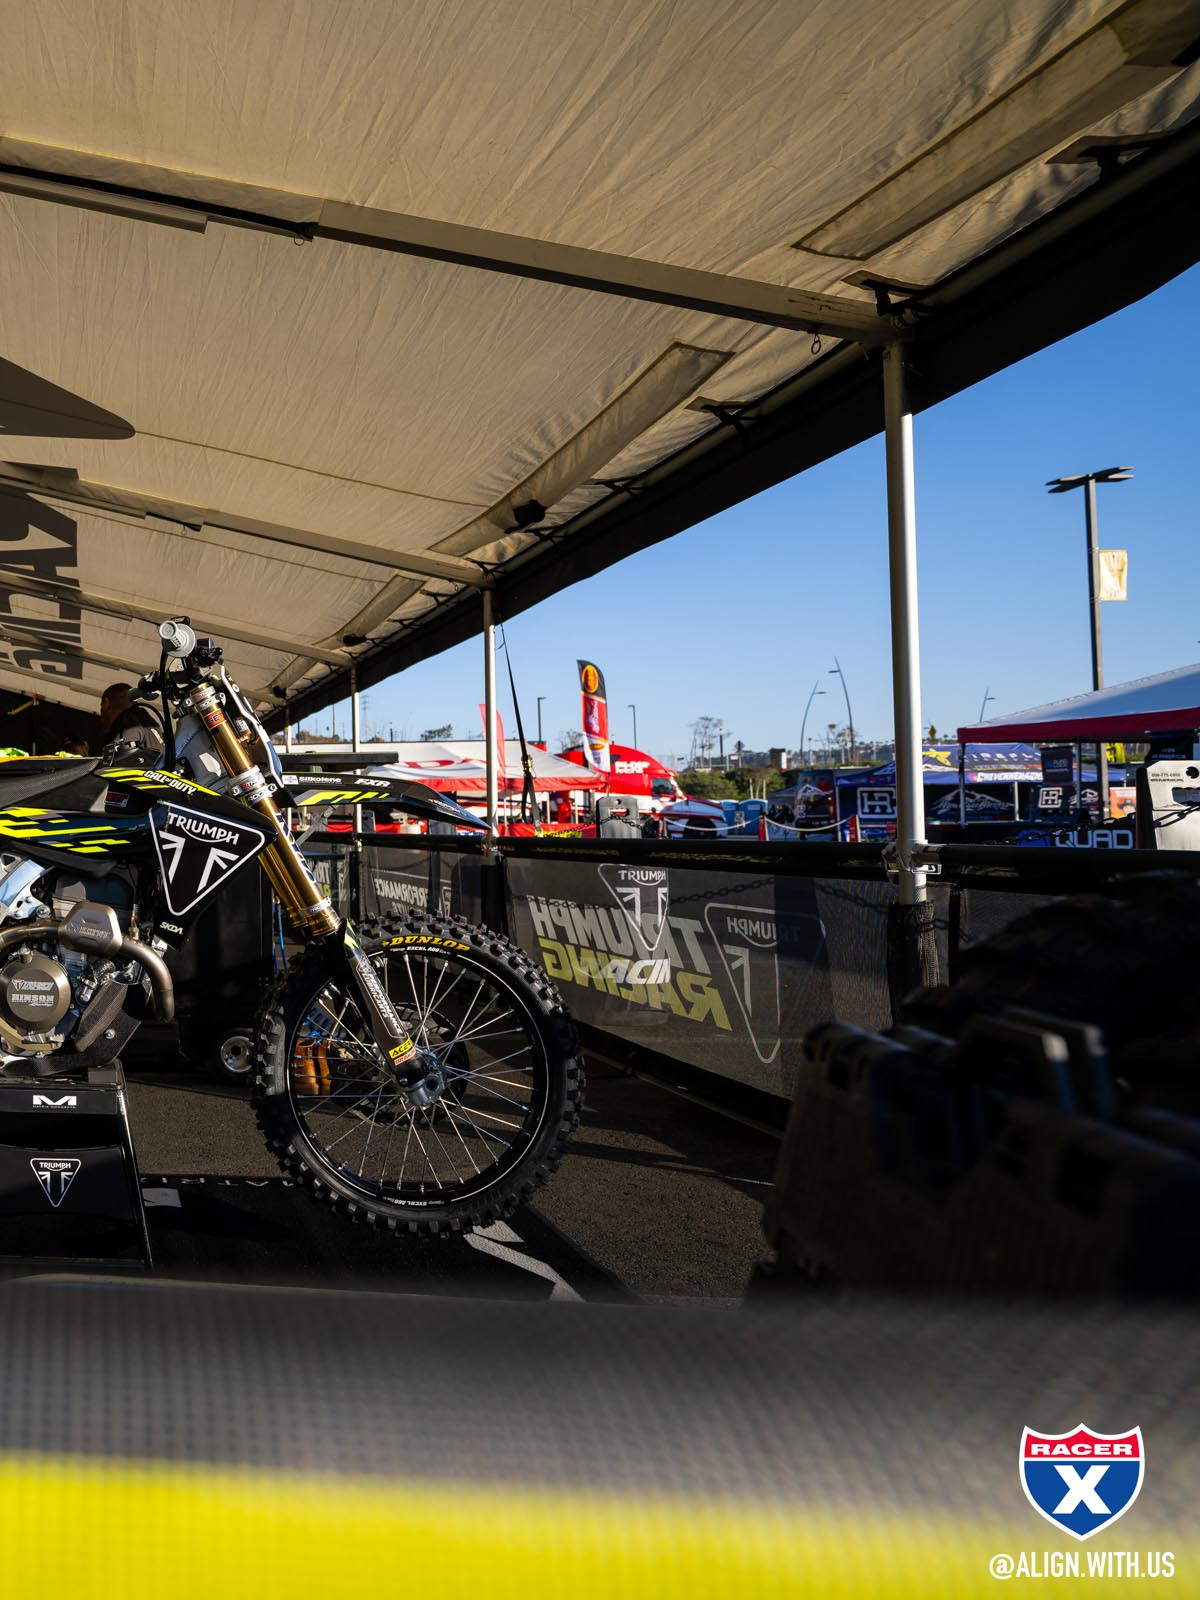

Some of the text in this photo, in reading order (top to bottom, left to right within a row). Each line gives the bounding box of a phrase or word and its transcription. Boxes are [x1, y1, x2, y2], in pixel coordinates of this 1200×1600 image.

[144, 770, 164, 783] CALL
[169, 779, 198, 795] DUTY
[167, 811, 240, 846] TRIUMPH
[1054, 829, 1134, 849] QUAD
[618, 870, 667, 884] TRIUMPH
[160, 920, 184, 935] SKDA
[389, 936, 471, 951] DUNLOP
[39, 1162, 71, 1171] TRIUMPH
